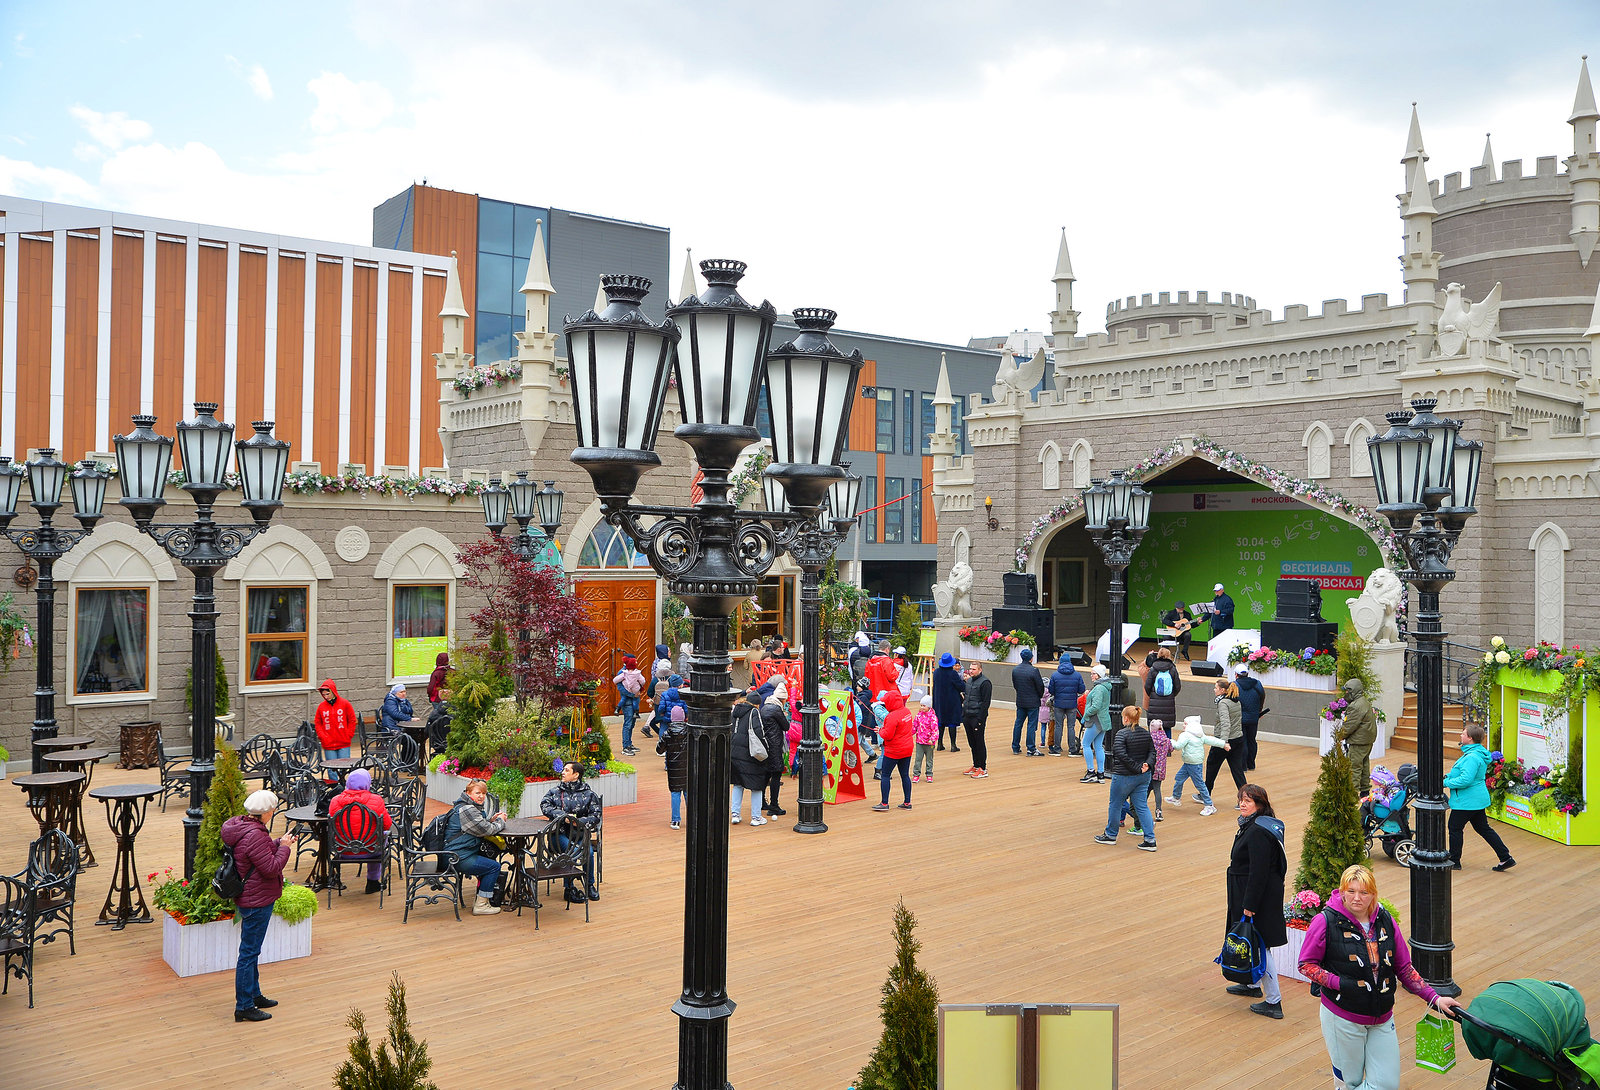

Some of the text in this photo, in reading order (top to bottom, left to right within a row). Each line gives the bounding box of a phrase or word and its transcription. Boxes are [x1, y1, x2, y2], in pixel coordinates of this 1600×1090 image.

[1239, 551, 1266, 561] 10.05
[1281, 563, 1351, 574] ФЕСТИВАЛЬ
[1281, 577, 1363, 589] ОВСКАЯ
